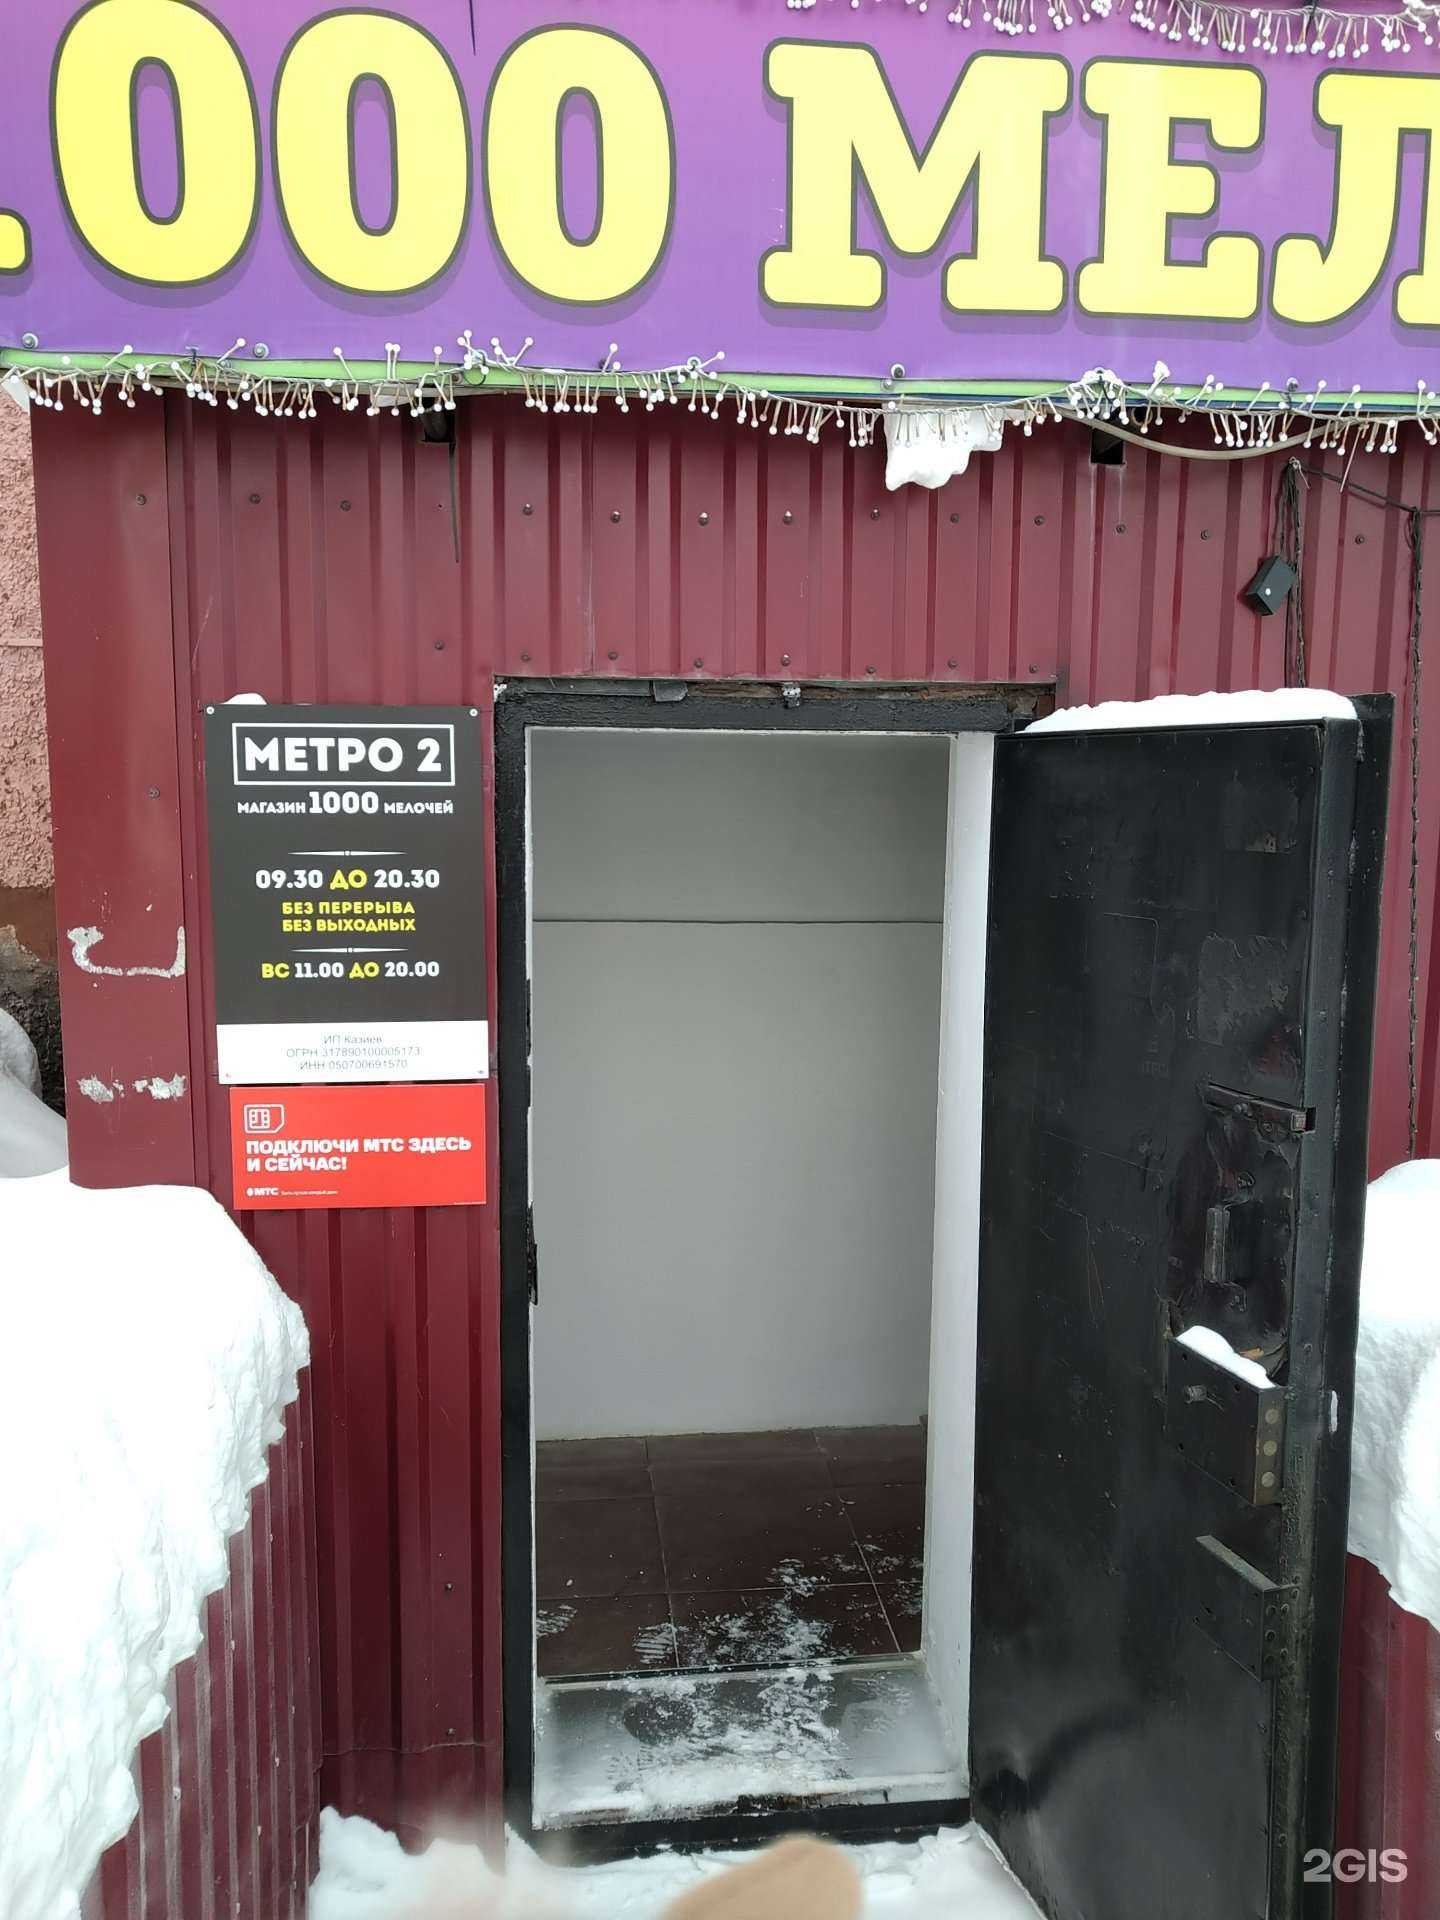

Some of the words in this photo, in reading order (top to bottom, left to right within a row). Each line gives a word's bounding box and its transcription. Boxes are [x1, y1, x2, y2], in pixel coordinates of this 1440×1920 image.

[0, 0, 676, 304] 000
[760, 37, 1440, 326] МЕЛ
[244, 737, 404, 773] МЕТРО
[416, 737, 442, 772] 2
[237, 801, 307, 814] МАГАЗИН
[309, 791, 380, 814] 1000
[384, 800, 454, 814] МЕЛОЧЕЙ
[255, 869, 323, 888] 09.30
[329, 870, 367, 890] ДО
[374, 869, 440, 888] 20.30
[282, 902, 314, 915] БЕЗ
[319, 901, 415, 914] ПЕРЕРЫВА
[282, 919, 312, 932] БЕЗ
[316, 919, 416, 932] ВЫХОДНЫХ
[261, 963, 290, 978] ВС
[294, 962, 344, 978] 11.00
[349, 962, 380, 979] ДО
[385, 961, 440, 977] 20.00
[323, 1035, 341, 1044] ИП
[286, 1048, 318, 1058] ОГРН
[300, 1061, 325, 1071] ИНН
[246, 1138, 360, 1156] ПОДКЛЮЧИ
[363, 1137, 404, 1152] МТС
[408, 1136, 472, 1153] ЗДЕСЬ
[247, 1158, 260, 1172] И
[265, 1154, 348, 1172] СЕЙЧАС!
[253, 1187, 279, 1196] МТС
